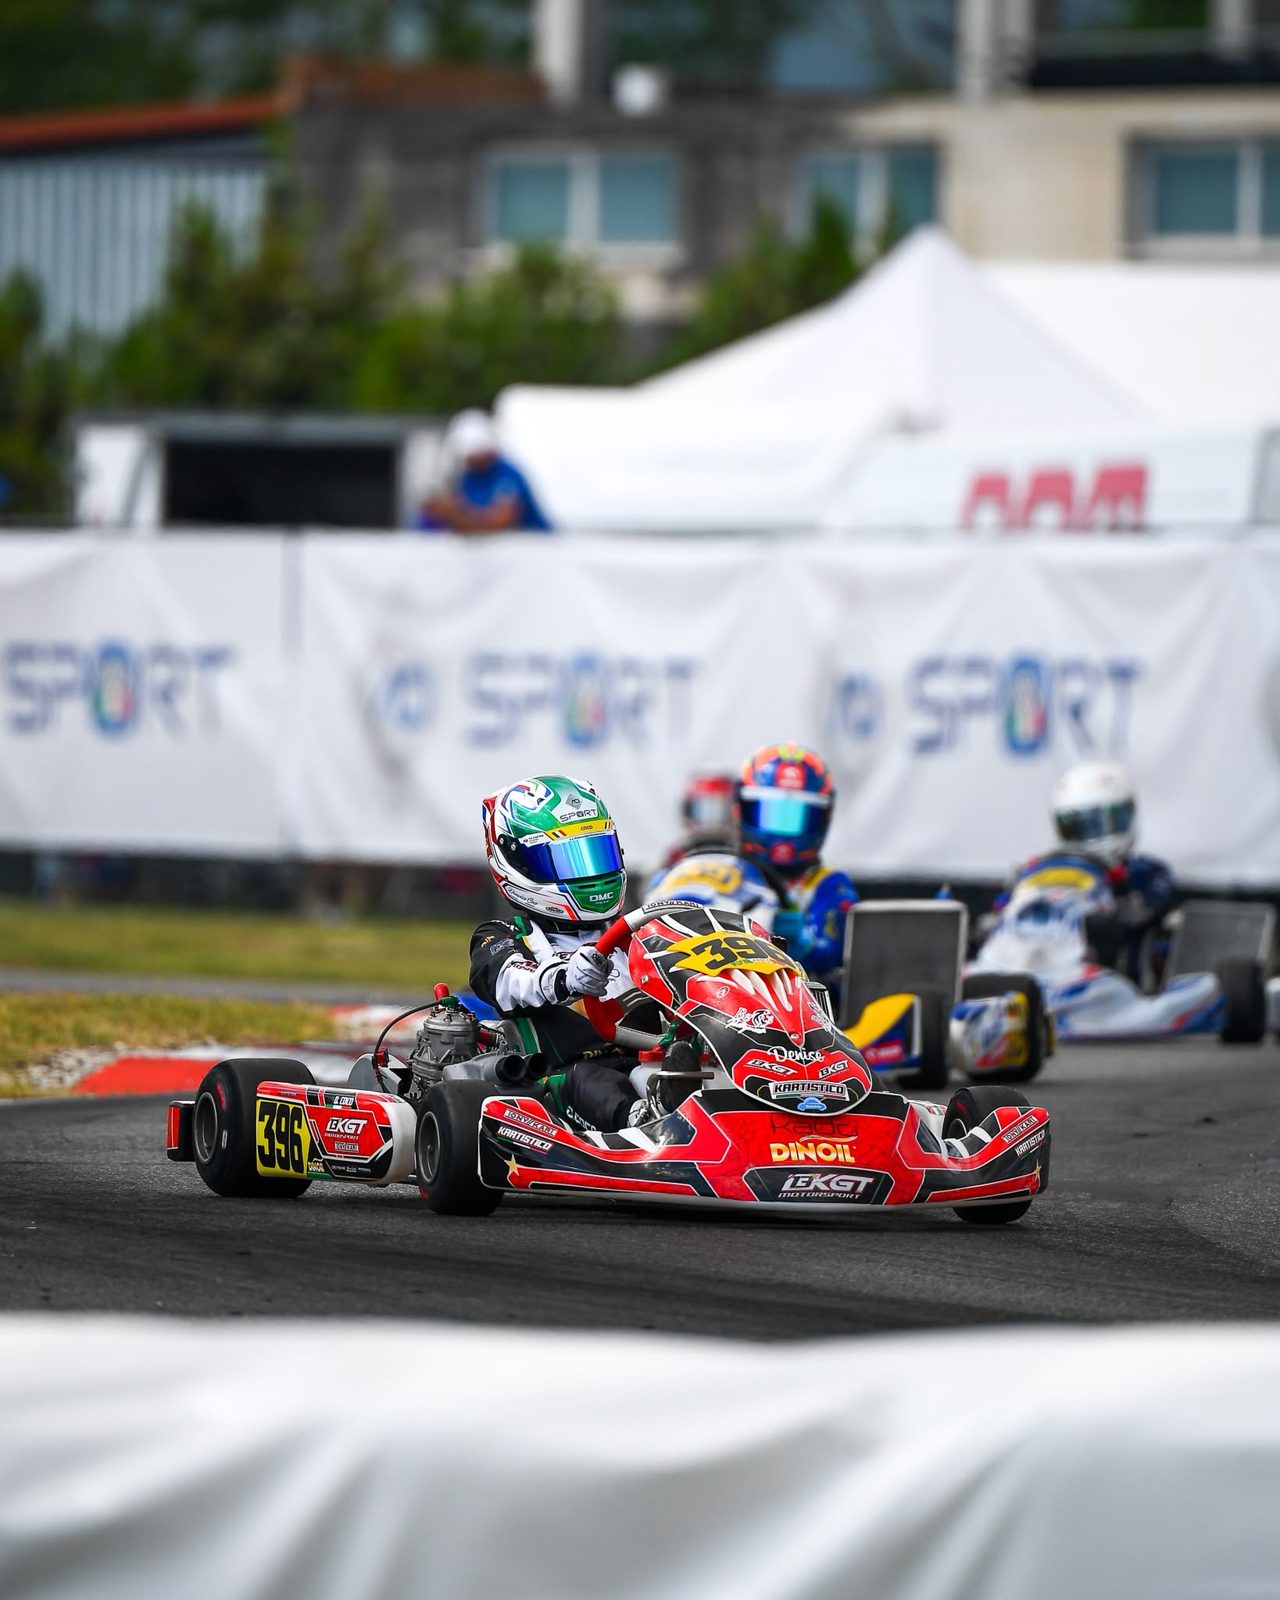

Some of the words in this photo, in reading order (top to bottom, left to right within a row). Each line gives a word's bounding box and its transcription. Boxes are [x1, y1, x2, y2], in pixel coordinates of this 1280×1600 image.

[4, 640, 236, 737] SPORT
[466, 650, 698, 751] SPORT
[908, 651, 1145, 758] SPORT
[559, 808, 597, 823] SPORT
[589, 891, 615, 902] DMC
[692, 936, 797, 971] 396
[767, 1045, 825, 1063] Denise
[774, 1083, 844, 1095] KARTISTICO
[257, 1101, 305, 1174] 396
[498, 1126, 553, 1151] KARTISTICO
[769, 1141, 856, 1164] DINOIL
[778, 1191, 861, 1200] MOTORSPORT
